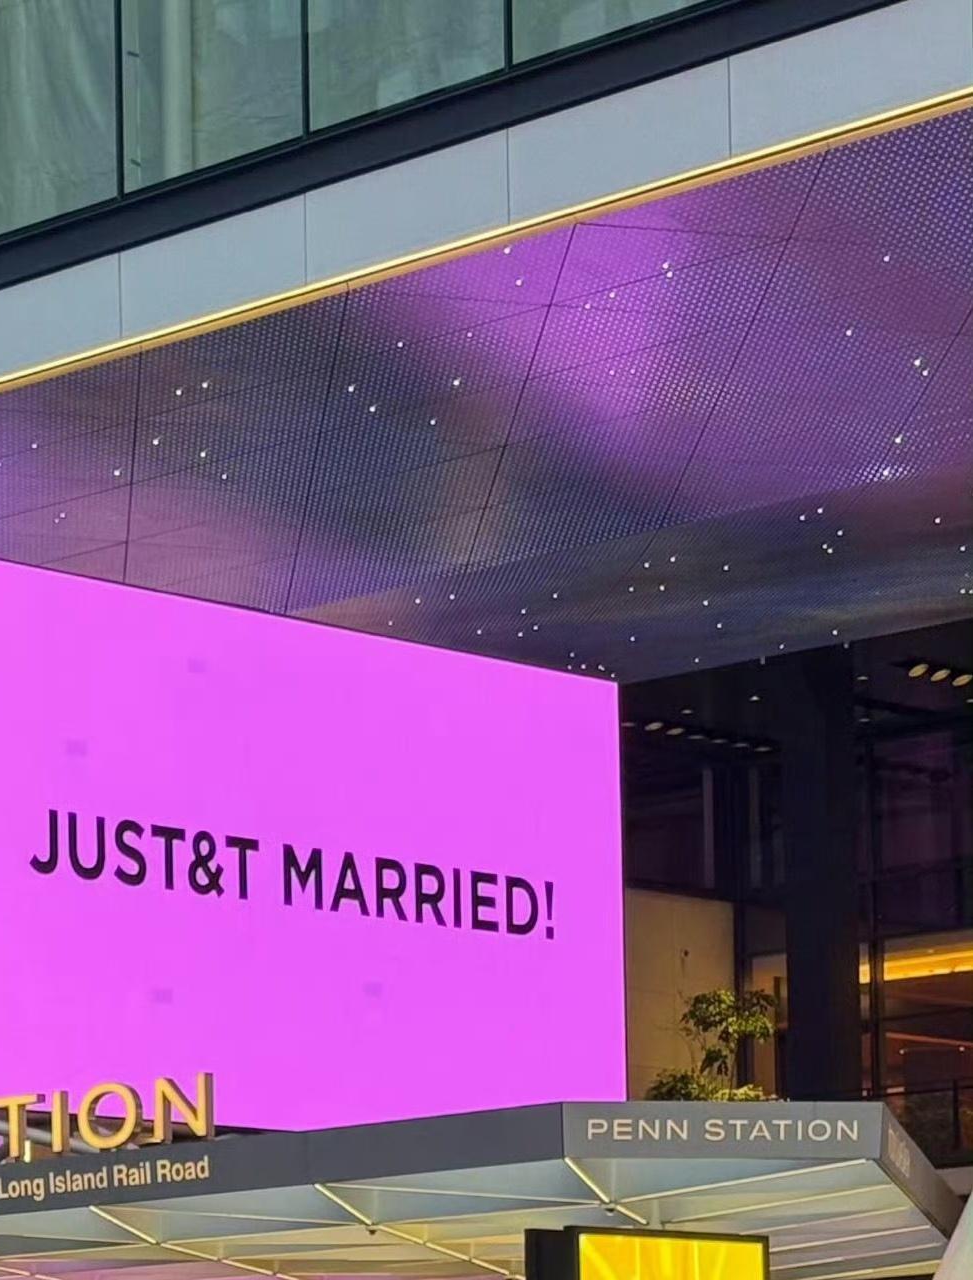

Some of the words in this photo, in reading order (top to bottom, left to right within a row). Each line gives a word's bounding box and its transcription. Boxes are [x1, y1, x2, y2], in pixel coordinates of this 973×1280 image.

[29, 809, 259, 899] JUST&T
[282, 843, 555, 939] MARRIED!
[587, 1118, 688, 1141] PENN
[704, 1118, 858, 1142] STATION
[49, 1167, 108, 1195] Island
[113, 1158, 152, 1187] Rail
[156, 1155, 210, 1185] Road
